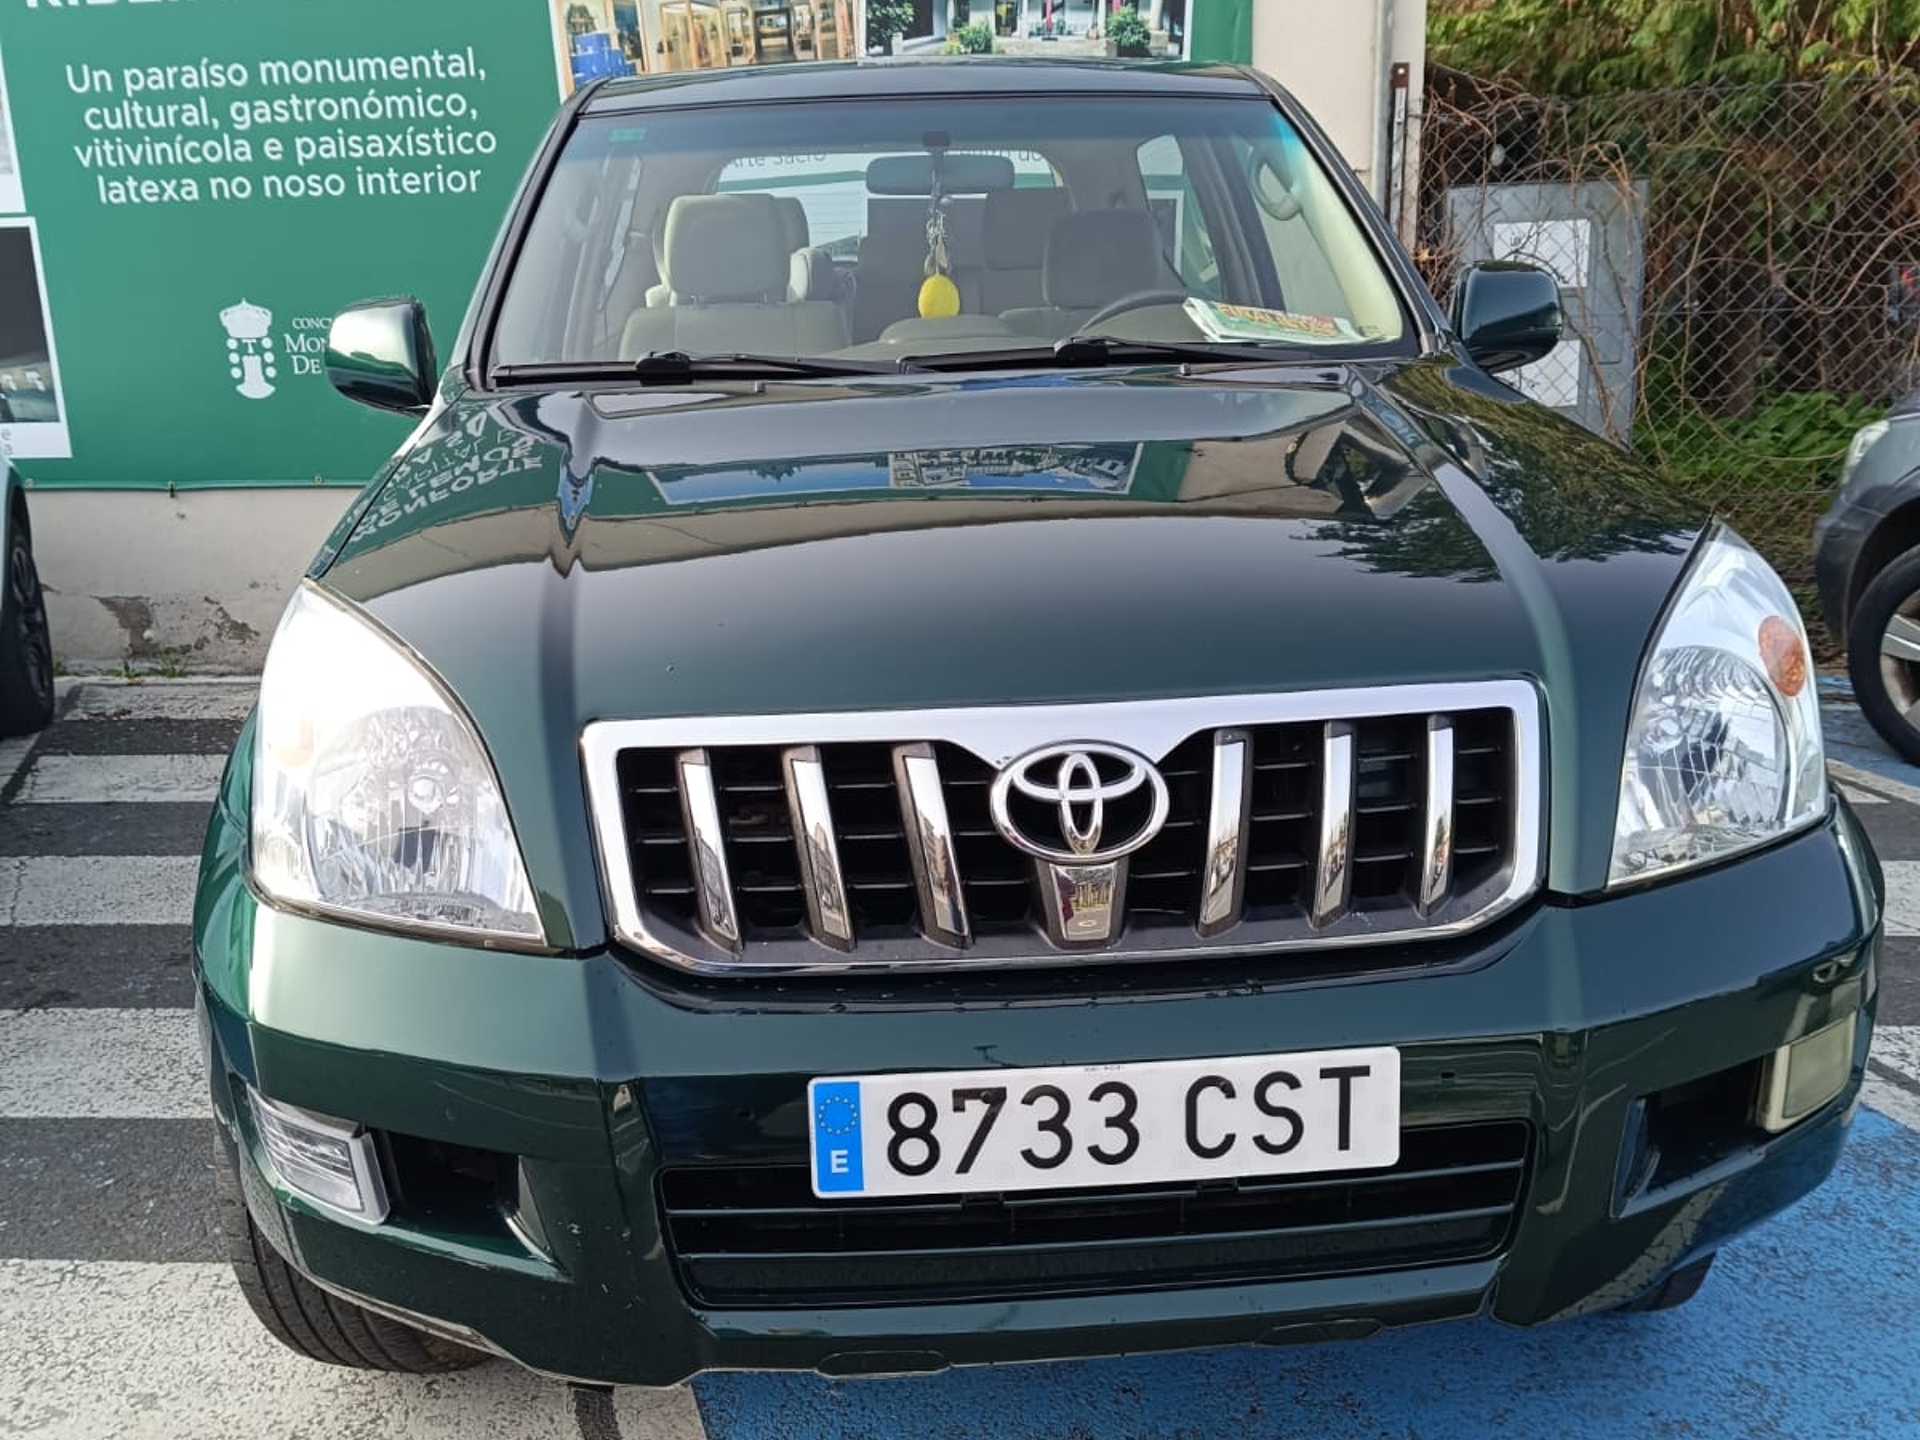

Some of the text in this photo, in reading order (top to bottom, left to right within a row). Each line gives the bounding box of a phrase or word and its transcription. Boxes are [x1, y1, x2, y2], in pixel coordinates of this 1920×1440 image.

[66, 46, 486, 98] Un paraíso monumental,
[84, 87, 478, 131] cultural, gastronómico,
[74, 126, 497, 168] vitivinícola e paisaxístico
[97, 164, 482, 204] latexa no noso interior
[292, 317, 331, 329] CONC
[887, 1065, 1371, 1176] 8733 CST
[830, 1149, 849, 1174] E
